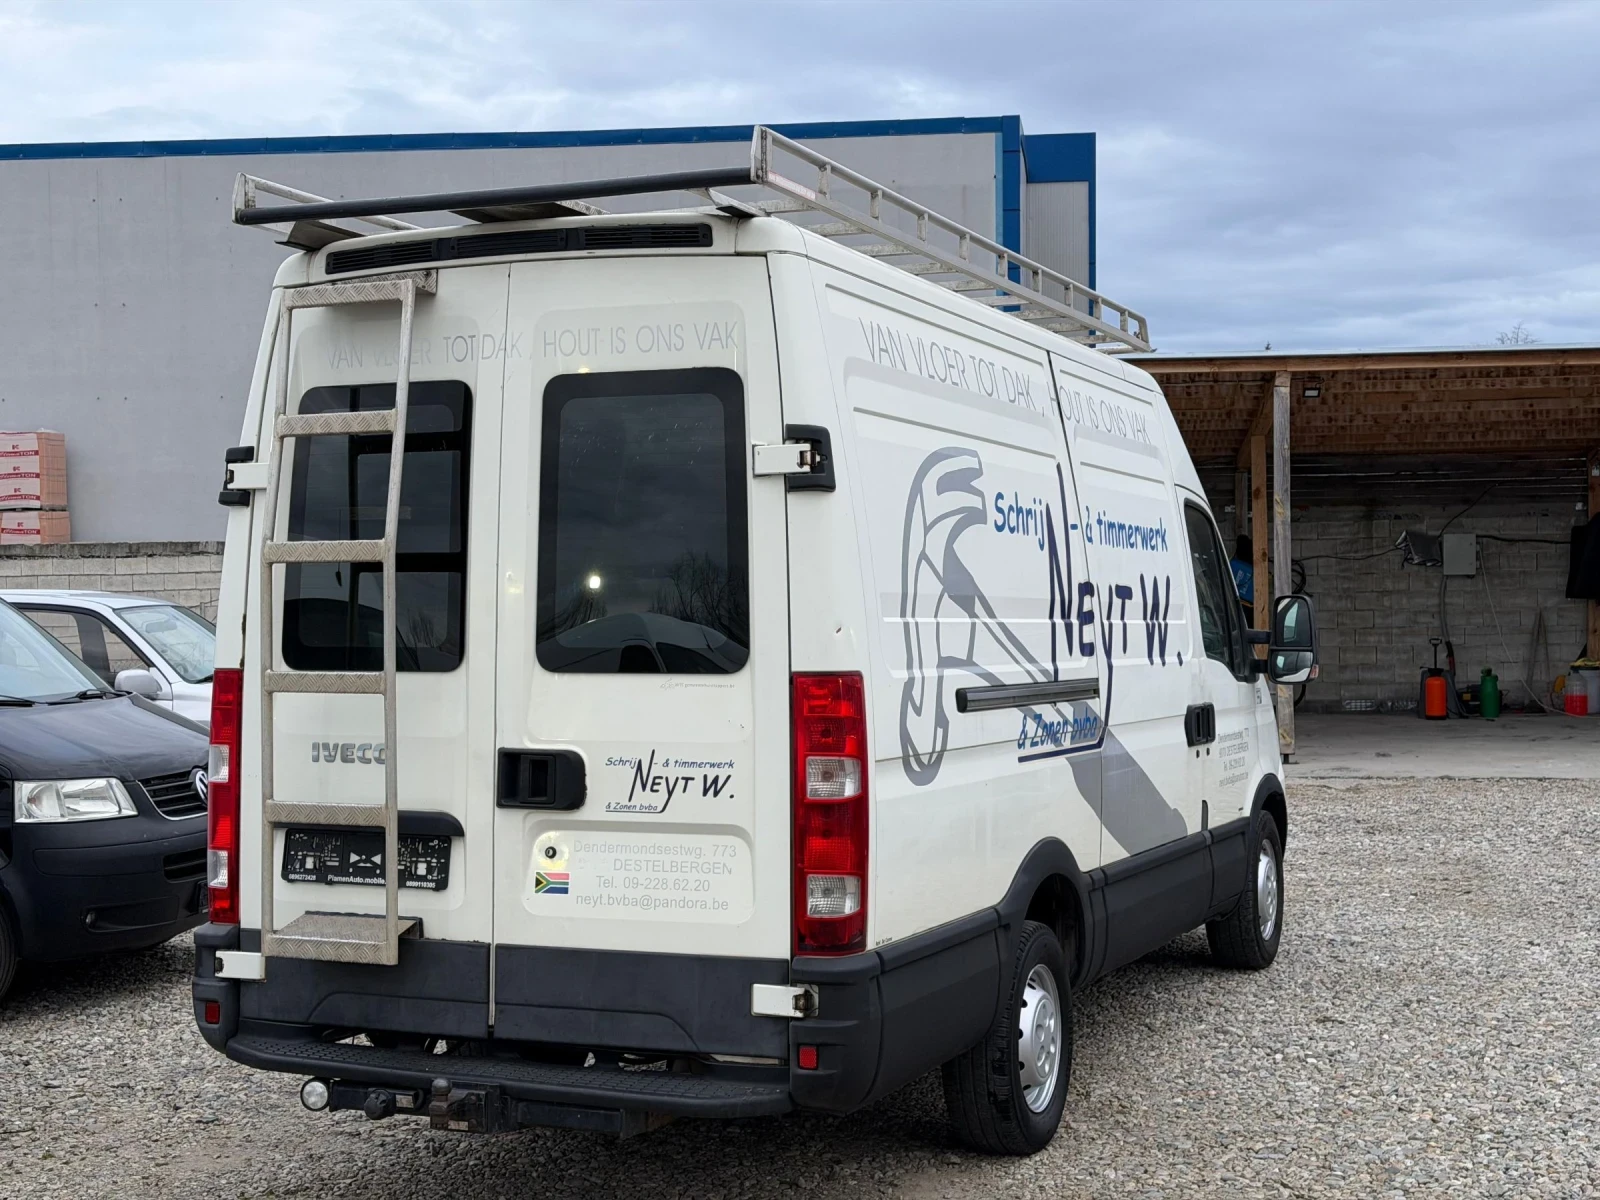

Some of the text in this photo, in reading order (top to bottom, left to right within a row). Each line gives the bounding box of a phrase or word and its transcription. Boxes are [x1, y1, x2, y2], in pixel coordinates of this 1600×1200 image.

[443, 335, 476, 363] TOT
[543, 328, 601, 358] HOUT
[610, 326, 626, 355] IS
[636, 323, 685, 353] ONS
[693, 320, 738, 350] VAK
[859, 317, 907, 372] VAN
[907, 333, 970, 391] VLOER
[969, 354, 1001, 400] TOT
[1047, 381, 1084, 425] HOUT
[1085, 395, 1099, 430] IS
[1100, 400, 1127, 438] ONS
[1127, 408, 1150, 445] VAK
[1096, 510, 1168, 552] timmerwerk
[1017, 714, 1028, 750] &
[1030, 713, 1068, 748] Zonen
[662, 758, 670, 768] &
[673, 758, 735, 769] timmerwerk
[702, 774, 734, 799] W.
[613, 802, 637, 810] Zonen
[639, 803, 658, 811] bvba
[574, 840, 737, 859] Dendermondsestwg. 773
[613, 858, 732, 875] DESTELBERGEN
[596, 875, 710, 892] Tel. 09-228.62.20
[576, 893, 729, 911] neyt.bvba@pandora.be
